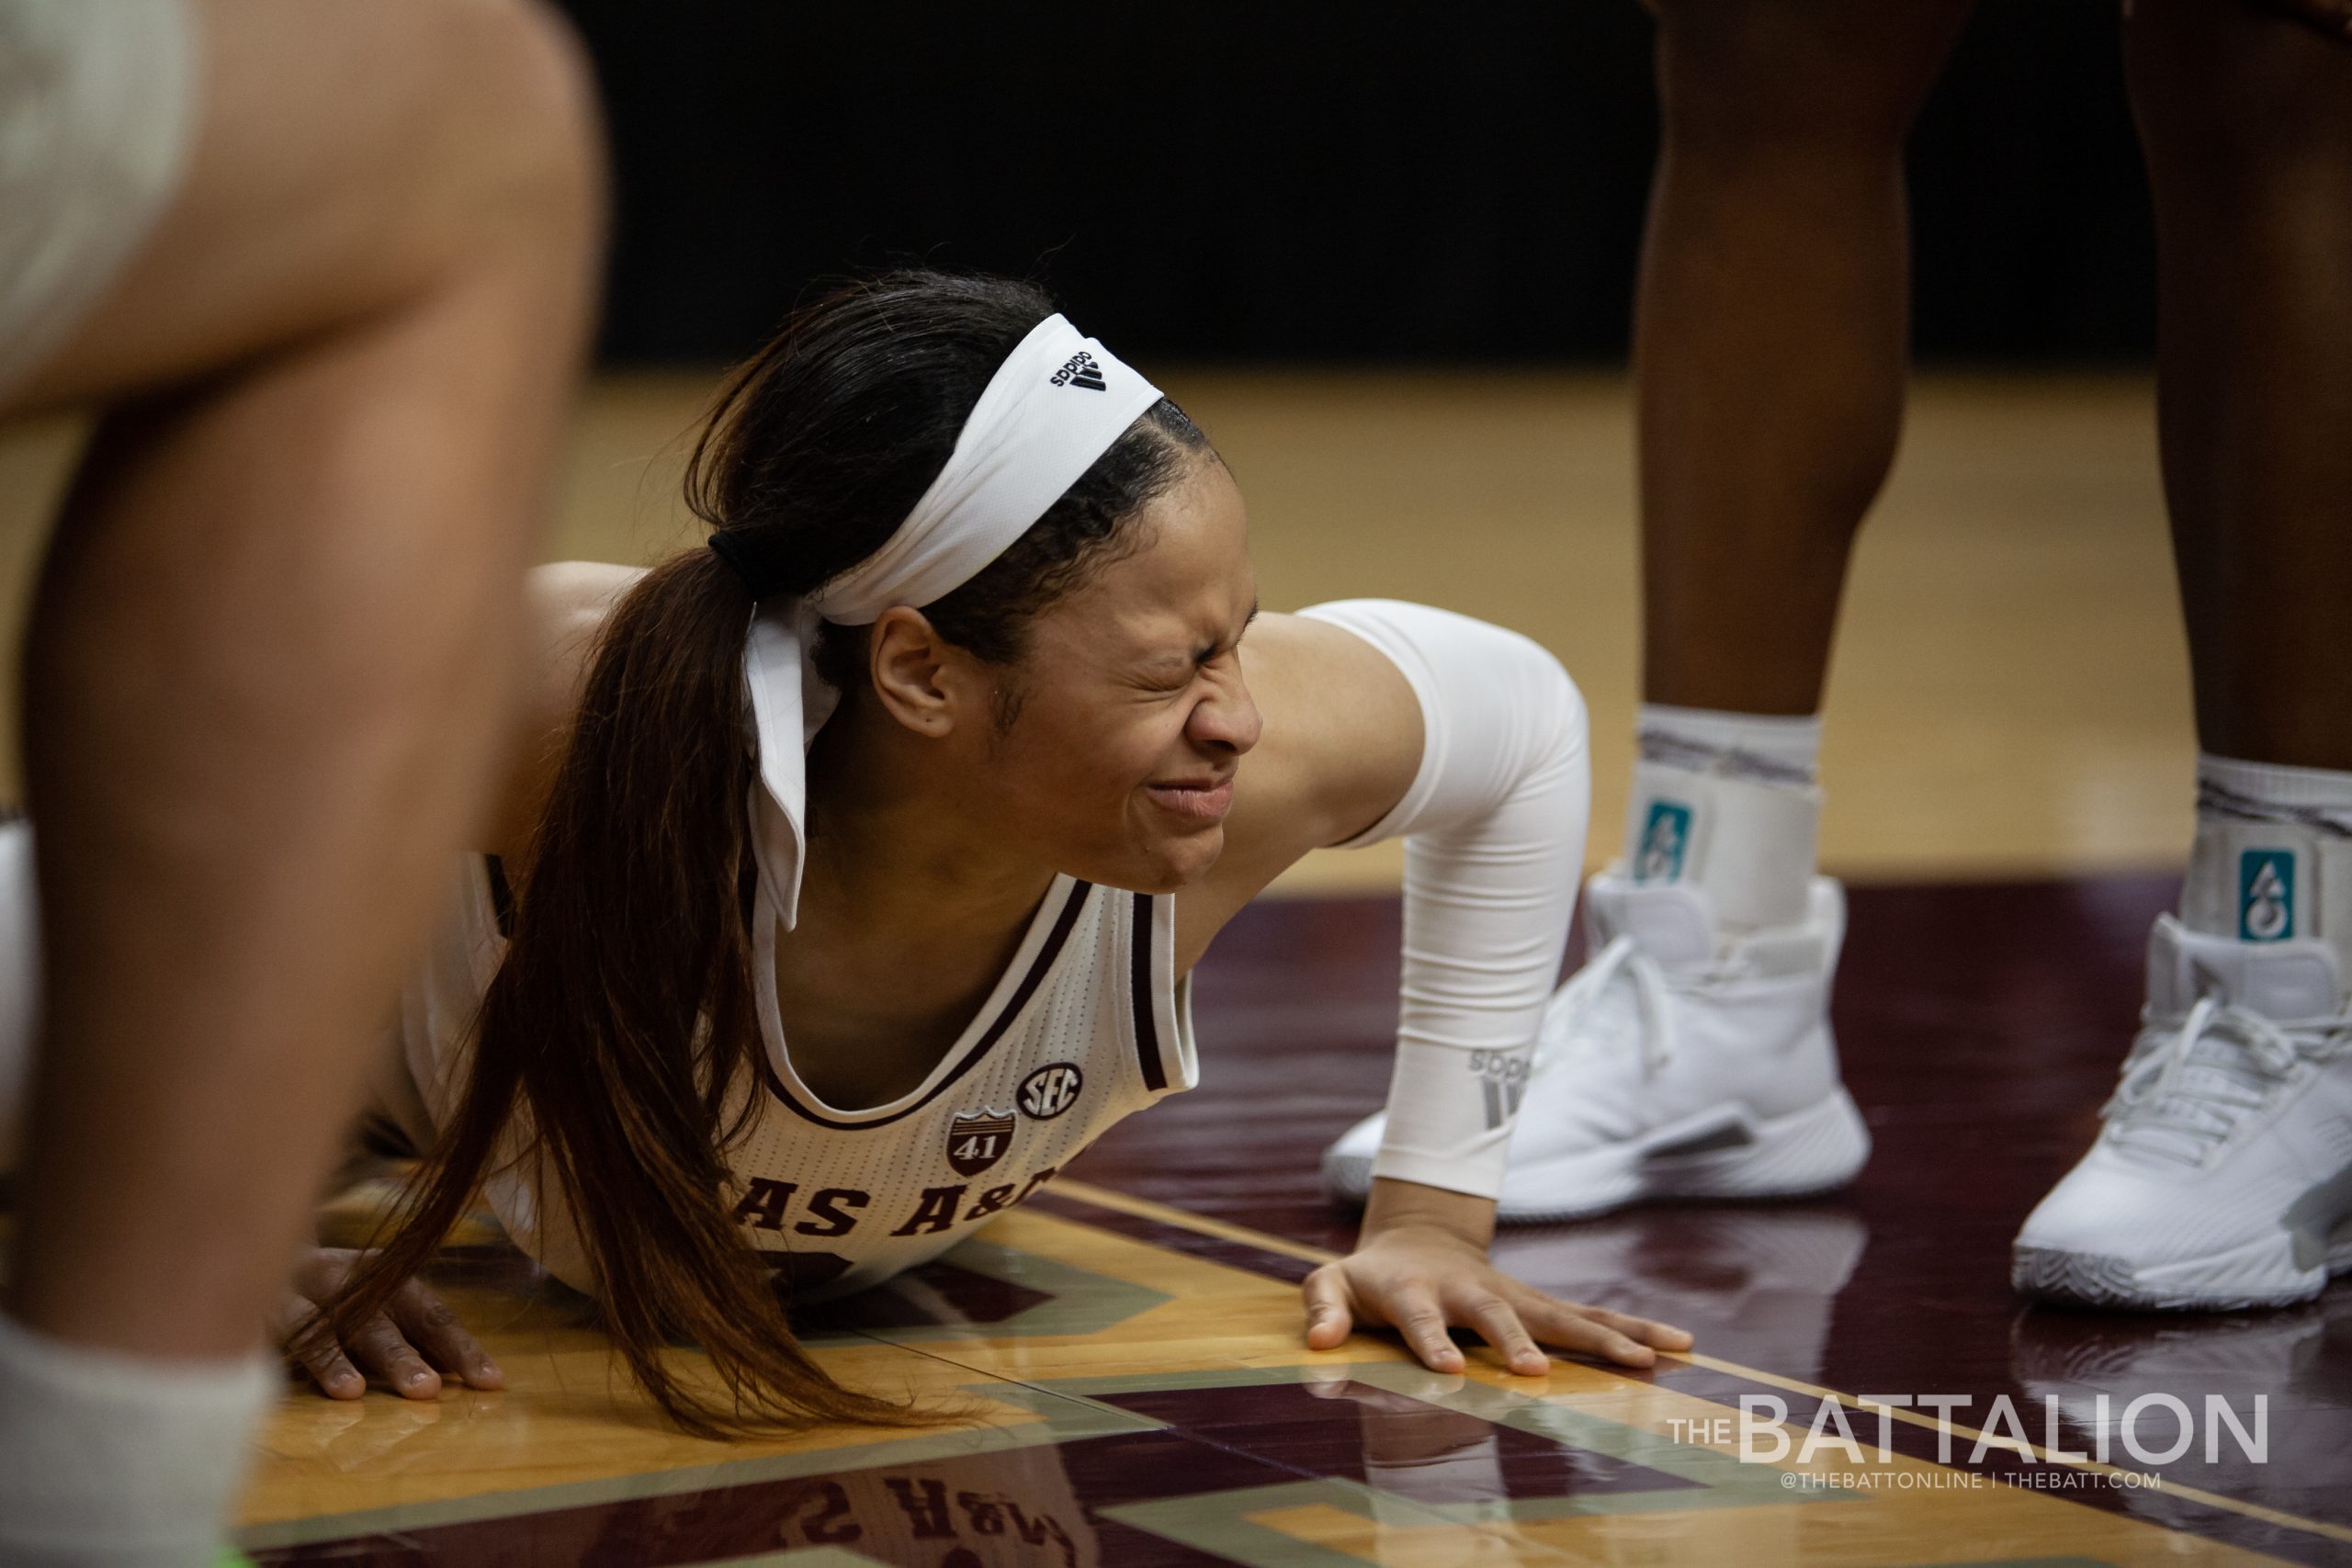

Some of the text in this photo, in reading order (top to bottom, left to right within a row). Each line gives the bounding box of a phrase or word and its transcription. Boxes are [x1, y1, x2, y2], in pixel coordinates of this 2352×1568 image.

[1050, 351, 1092, 387] adidas
[1023, 1068, 1079, 1116] SEC
[954, 1135, 998, 1161] 41
